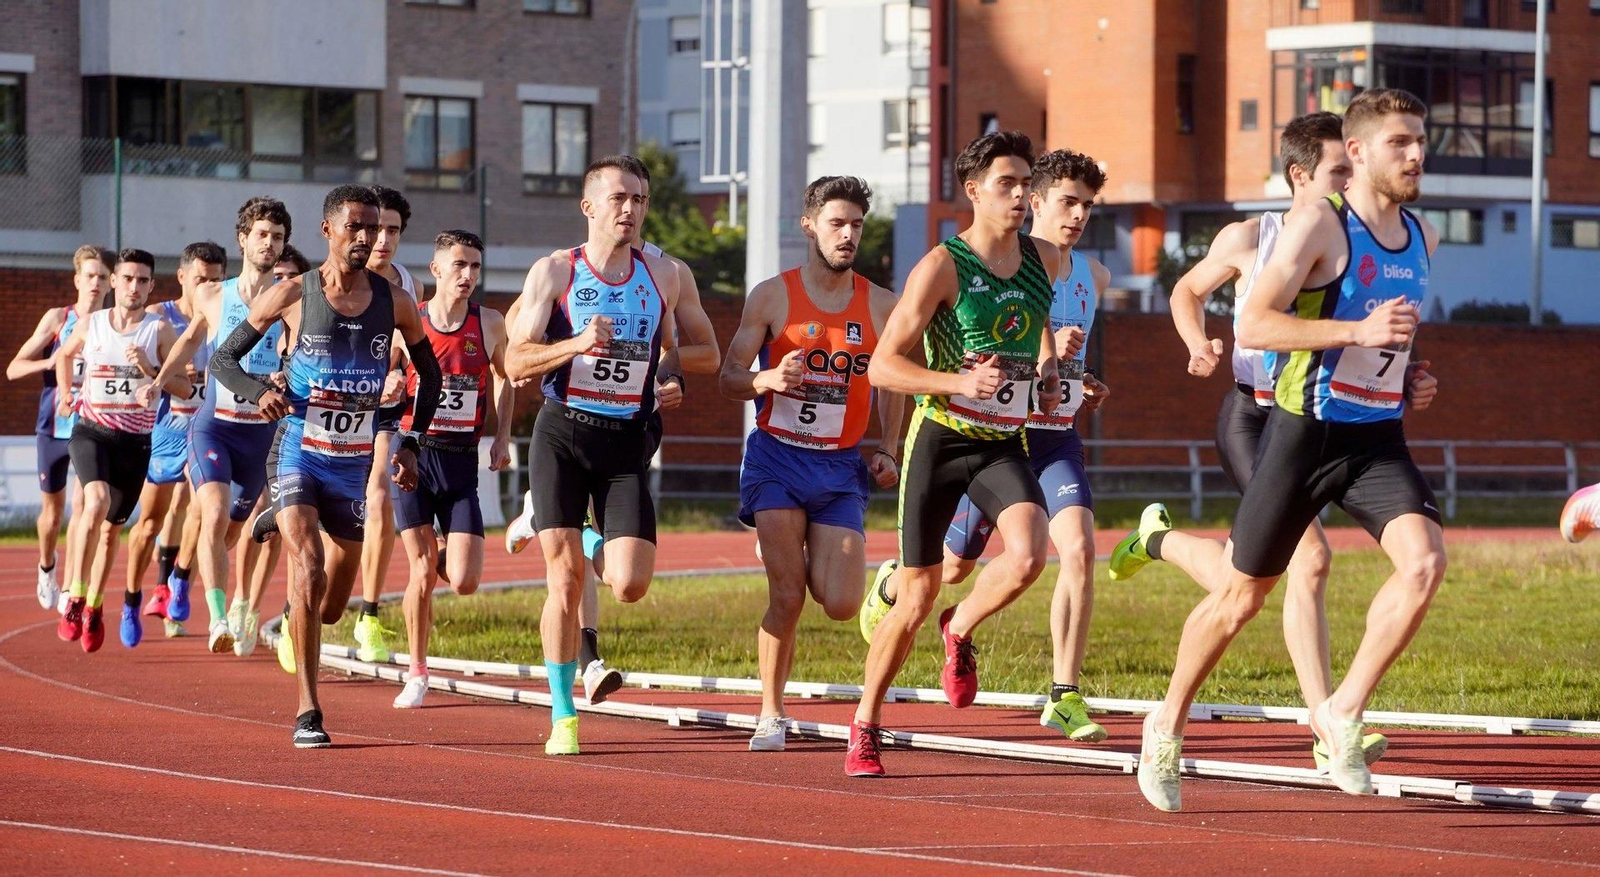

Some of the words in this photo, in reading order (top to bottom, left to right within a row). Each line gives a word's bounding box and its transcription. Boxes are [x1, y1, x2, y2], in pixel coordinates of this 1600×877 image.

[1383, 264, 1413, 279] blisa
[994, 290, 1025, 304] LUCUS
[593, 359, 631, 383] 55
[1376, 351, 1395, 377] 7
[105, 380, 132, 395] 54
[308, 376, 381, 394] NARÓN
[798, 403, 817, 424] 5
[980, 409, 999, 418] VIGO
[320, 410, 366, 434] 107
[331, 439, 348, 447] VIGO
